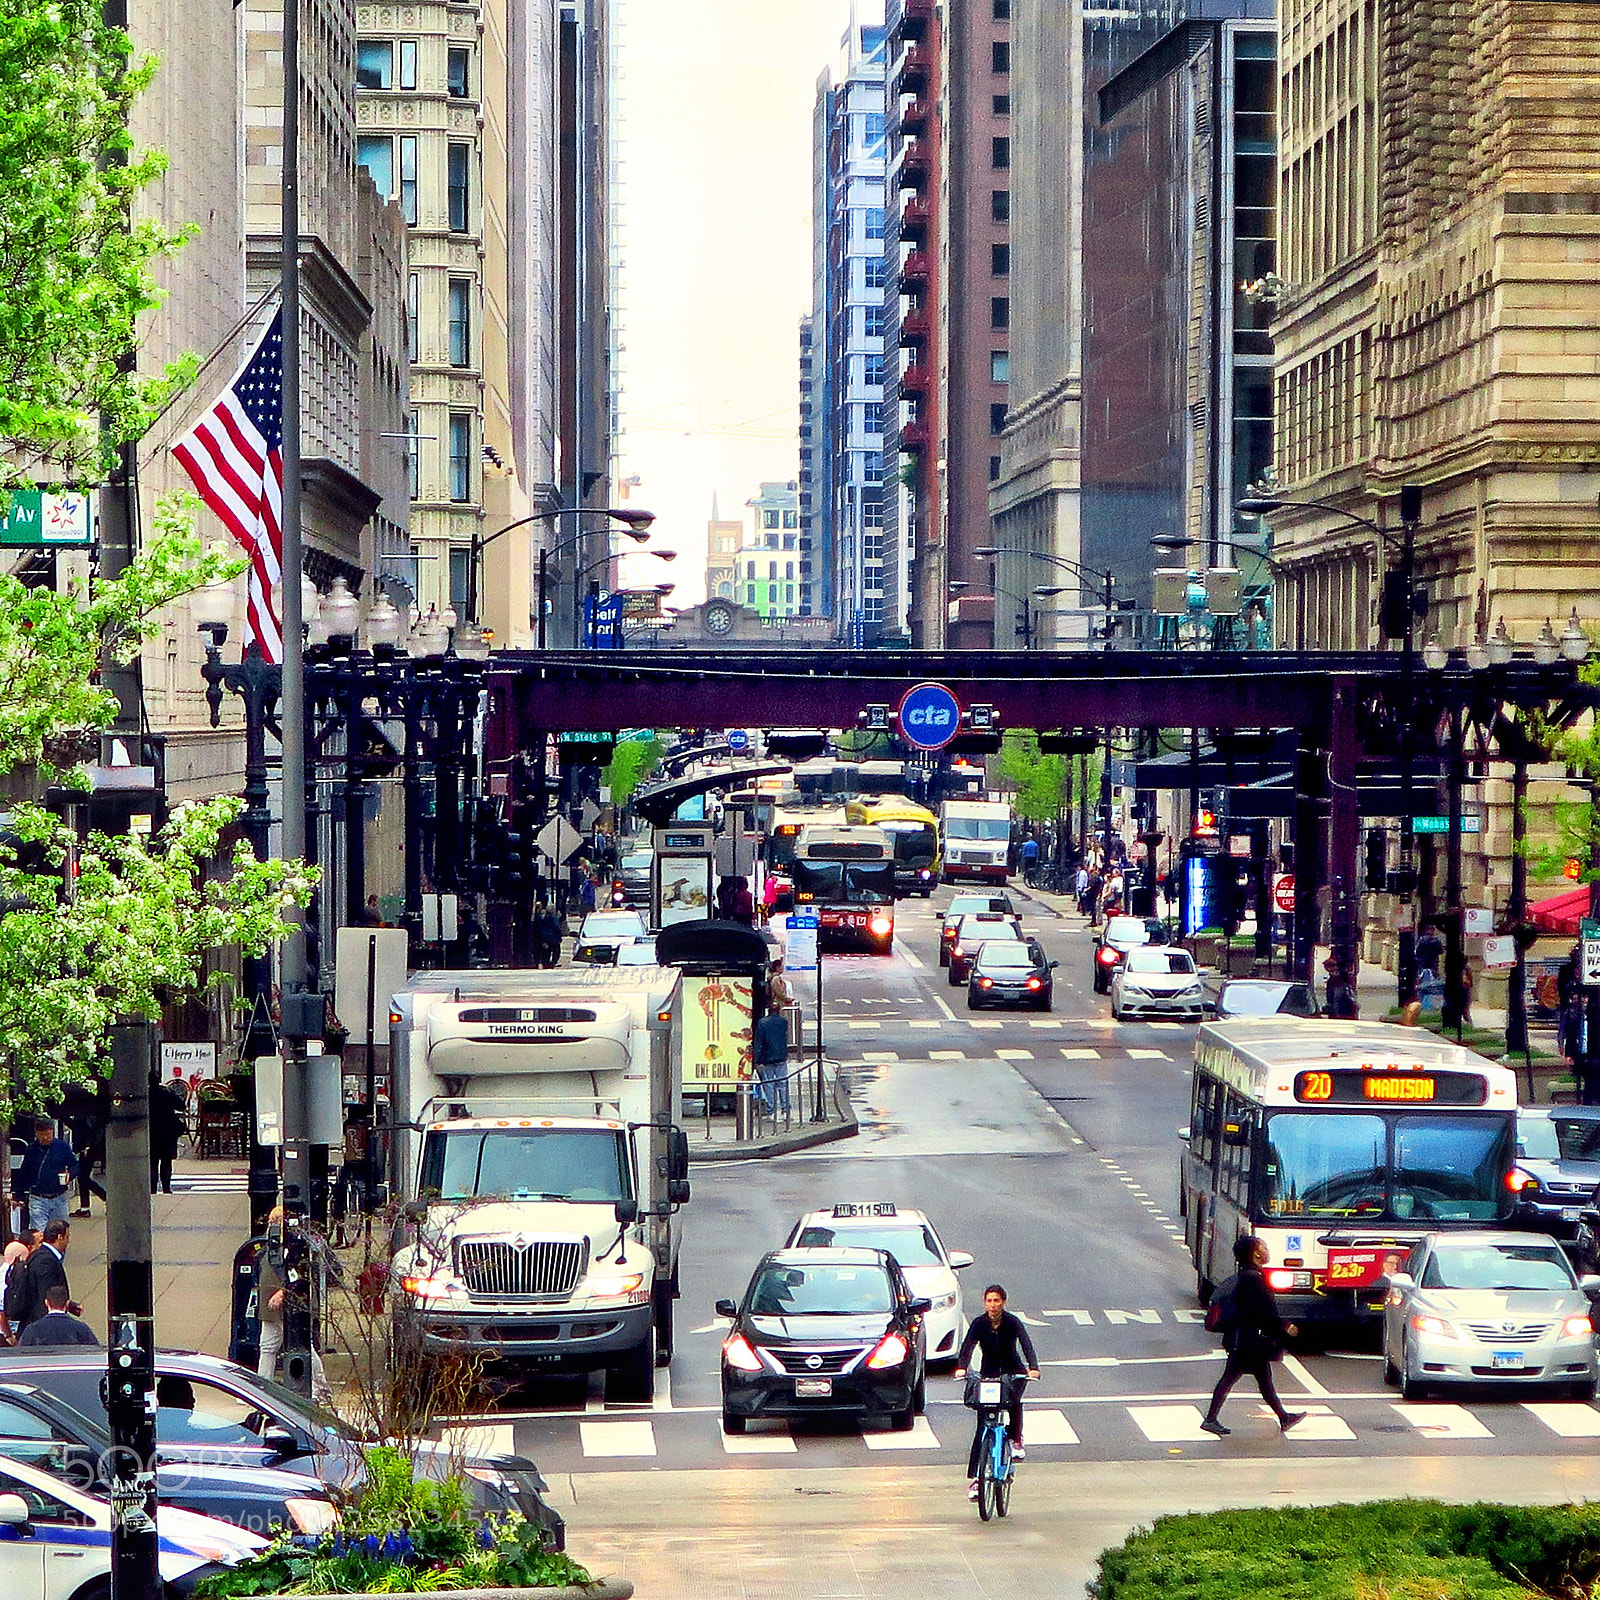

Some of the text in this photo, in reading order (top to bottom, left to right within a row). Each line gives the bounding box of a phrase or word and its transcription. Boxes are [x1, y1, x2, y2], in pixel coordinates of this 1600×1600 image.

[15, 505, 35, 523] Av
[909, 704, 951, 725] cta
[730, 735, 746, 743] cta
[488, 1025, 564, 1034] THERMO KING
[695, 1063, 731, 1079] ONE GOAL
[1304, 1072, 1332, 1099] 20
[1366, 1077, 1435, 1100] MADISON
[851, 1203, 880, 1217] 6115
